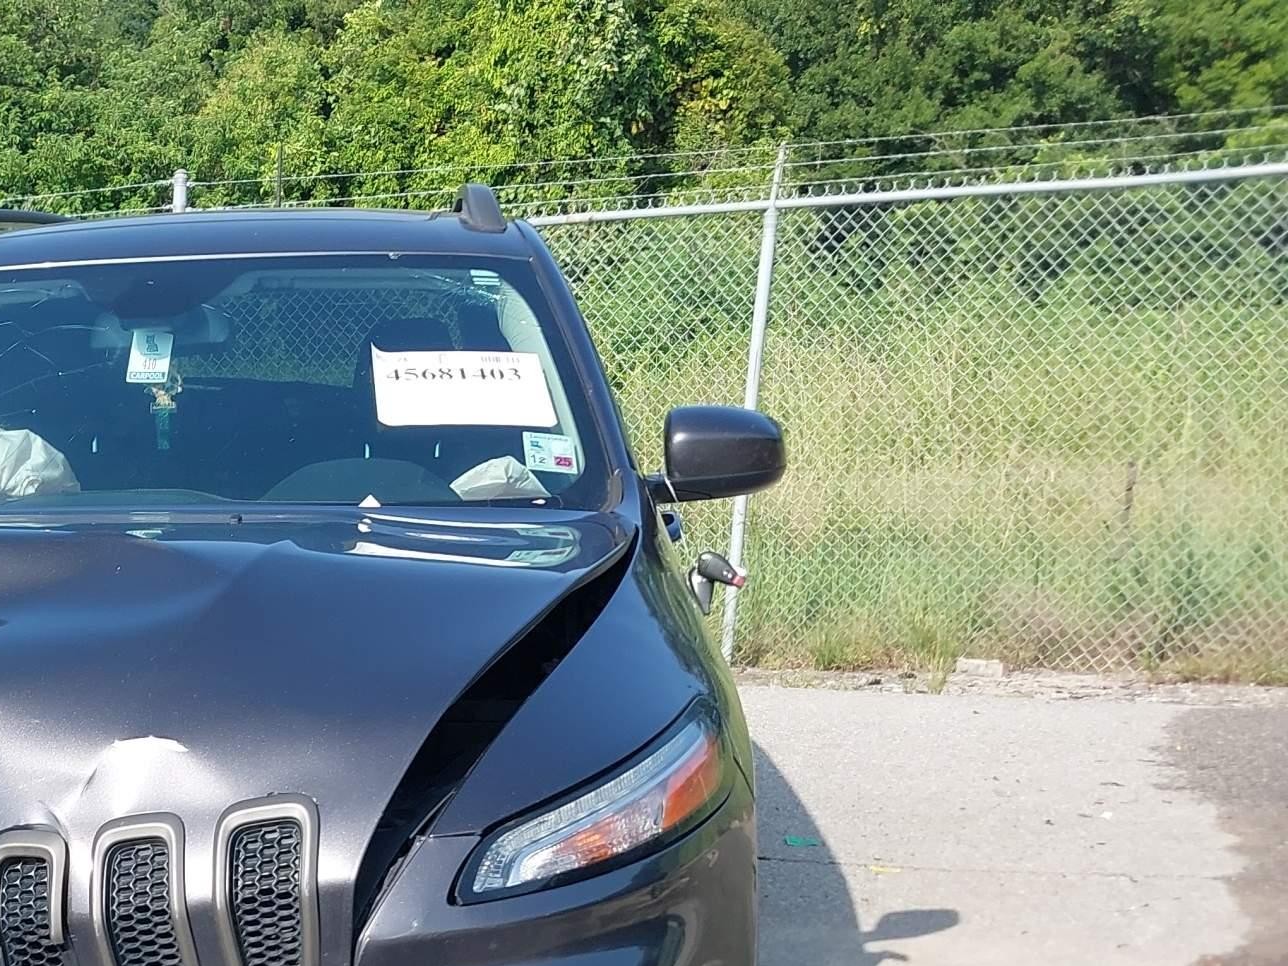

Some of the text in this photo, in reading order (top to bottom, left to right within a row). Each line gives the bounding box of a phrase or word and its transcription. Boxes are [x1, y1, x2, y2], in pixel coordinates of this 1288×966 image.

[131, 371, 164, 380] CARPOOL
[386, 367, 521, 381] 45681403
[530, 454, 572, 467] 12 25
